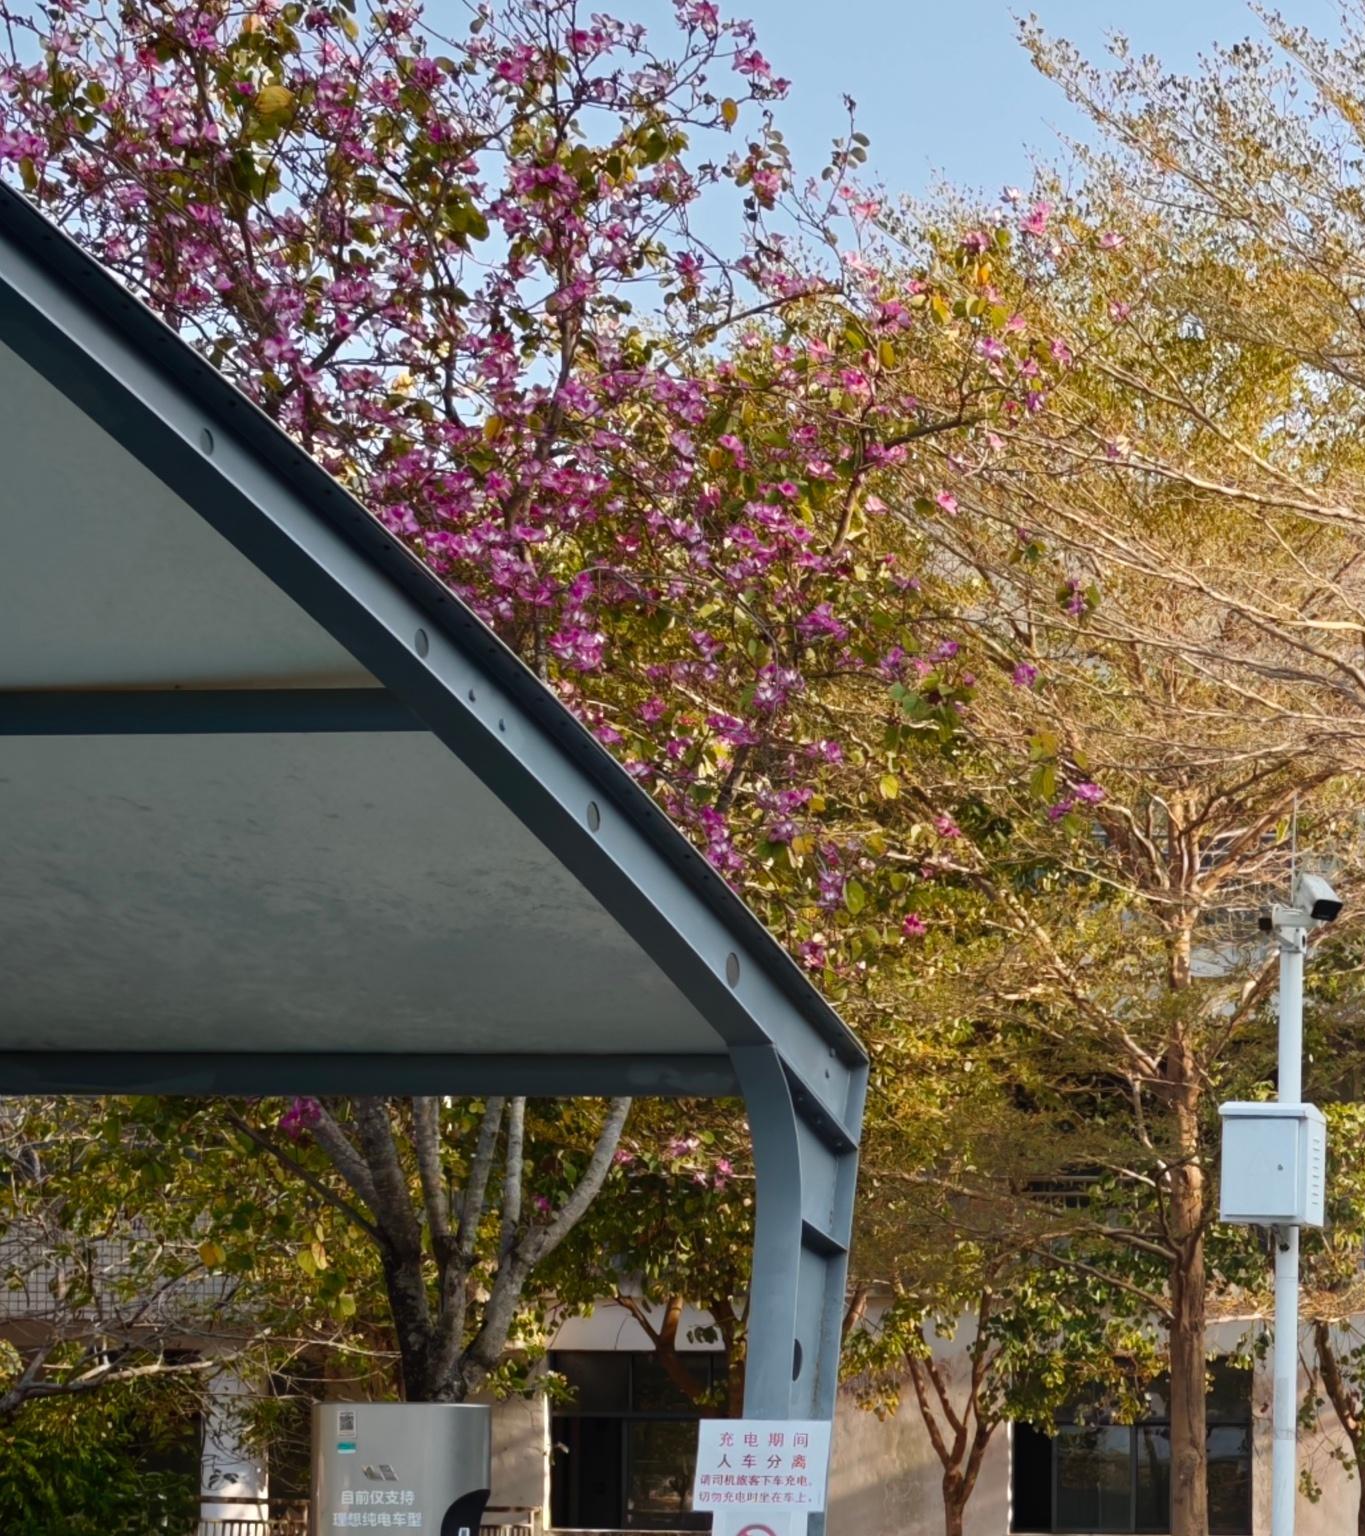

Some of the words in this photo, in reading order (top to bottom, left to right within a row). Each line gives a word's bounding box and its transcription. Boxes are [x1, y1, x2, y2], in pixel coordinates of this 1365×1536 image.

[719, 1432, 809, 1448] 充电期间
[717, 1453, 807, 1470] 人车分离
[340, 1490, 416, 1505] 目前仅支持
[332, 1511, 423, 1528] 理想纯电车型
